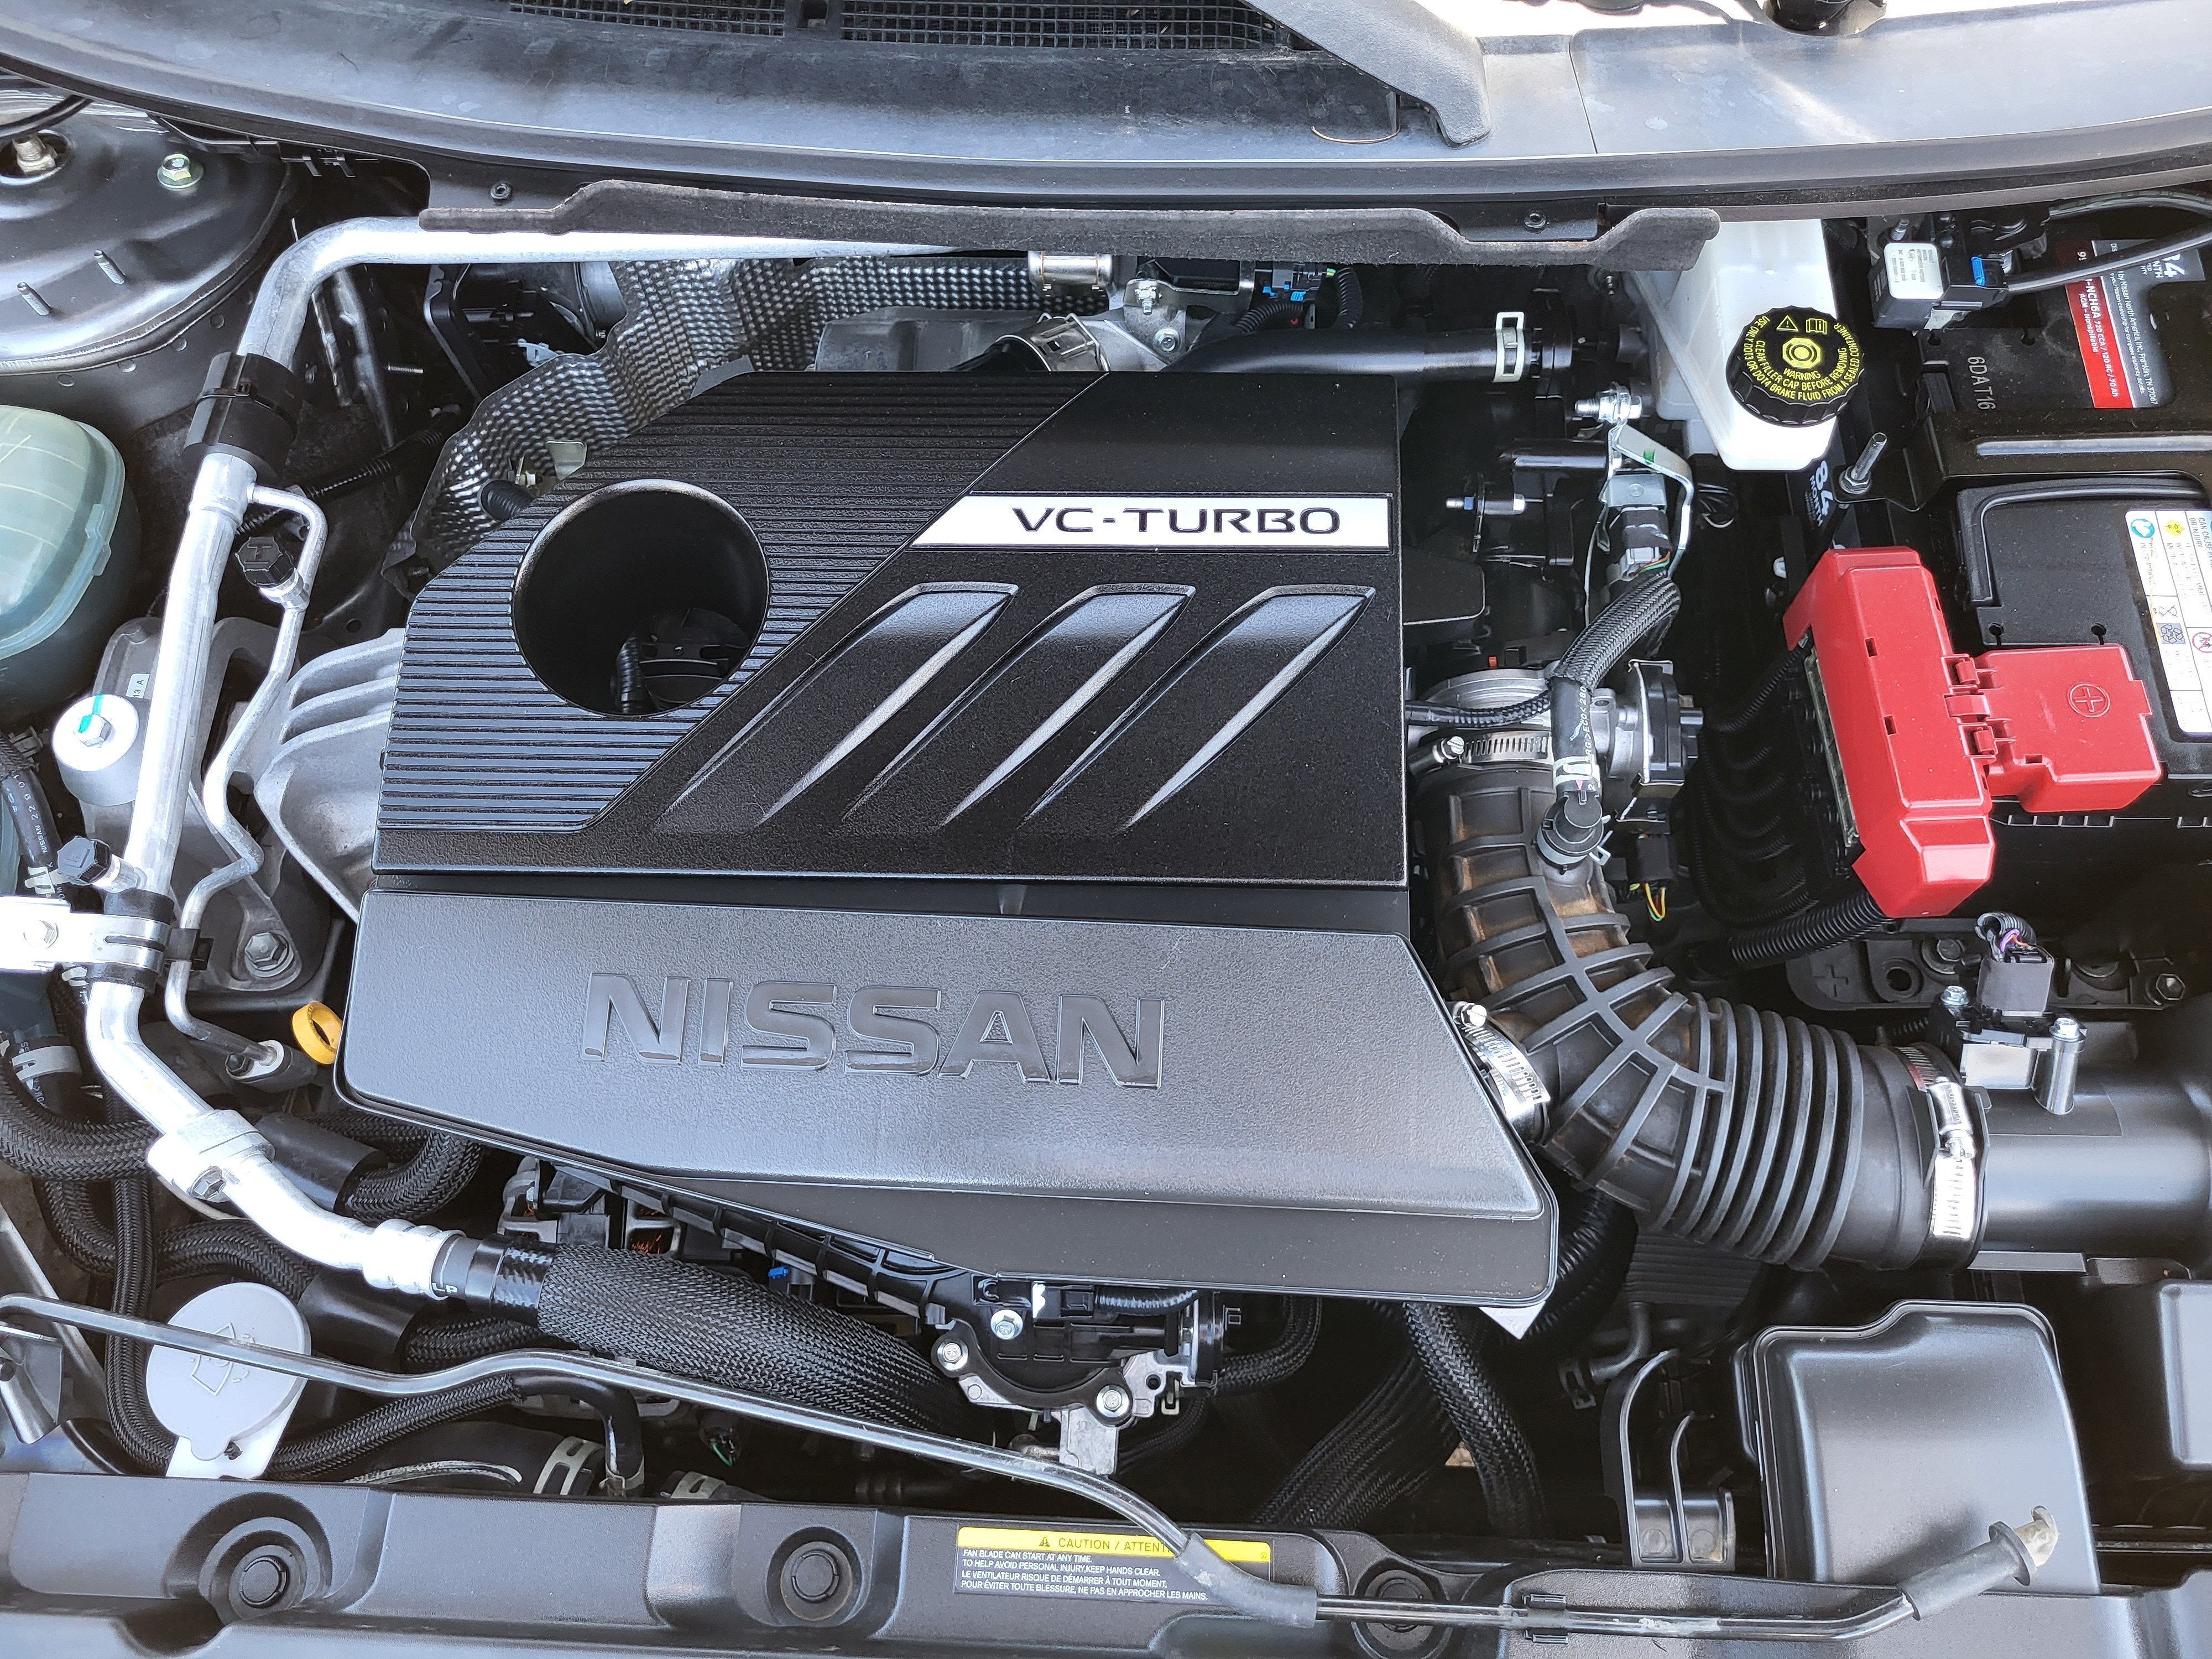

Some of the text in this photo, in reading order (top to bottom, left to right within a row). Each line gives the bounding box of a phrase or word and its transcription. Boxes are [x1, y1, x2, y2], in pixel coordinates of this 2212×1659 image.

[2153, 260, 2164, 278] NTH
[2120, 281, 2130, 300] Nissan
[2079, 293, 2088, 308] AGM
[2125, 300, 2135, 317] North
[1754, 316, 1770, 328] USE
[2094, 321, 2103, 333] 720
[1745, 326, 1759, 343] ONLY
[1833, 322, 1859, 357] CONTAINER
[2083, 314, 2099, 353] Nonspillable
[2097, 333, 2106, 346] CCA
[1743, 343, 1754, 361] DOT3
[2102, 352, 2110, 363] 120
[1746, 361, 1758, 371] OR
[1755, 340, 1848, 390] CLEAN FILLER CAP BEFORE REMOVING
[1844, 359, 1860, 382] SEALED
[2104, 364, 2113, 373] RC
[1752, 371, 1772, 388] DOT4
[1783, 368, 1821, 380] WARNING
[2108, 378, 2116, 387] 70
[2145, 377, 2153, 386] TN
[1770, 383, 1796, 400] BRAKE
[1967, 357, 1996, 409] 6DAT16
[1798, 391, 1821, 401] FLUID
[1821, 385, 1844, 399] FROM
[2110, 388, 2119, 397] Ah
[2147, 387, 2158, 405] 37067
[1815, 460, 1833, 516] 84
[1809, 474, 1823, 527] MONTH
[1011, 507, 1340, 535] VC-TURBO
[2198, 517, 2208, 530] CAN
[2192, 527, 2203, 547] INJURY
[34, 825, 49, 854] NISSAN
[580, 972, 1166, 1090] NISSAN
[1058, 1538, 1170, 1553] CAUTION / ATTENT
[963, 1549, 1093, 1563] FAN BLADE CAN START AT ANY TIME.
[962, 1558, 973, 1567] TO
[974, 1559, 994, 1568] HELP
[994, 1560, 1018, 1569] AVOID
[1019, 1561, 1058, 1571] PERSONAL
[1107, 1566, 1133, 1575] HANDS
[1134, 1567, 1161, 1577] CLEAR.
[962, 1569, 1167, 1588] LE VENTILATEUR RISQUE DE DÉMARRER À TOUT MOMENT.
[961, 1579, 1208, 1601] POUR ÉVITER TOUTE BLESSURE, NE PAS EN APPROCHER LES MAINS.
